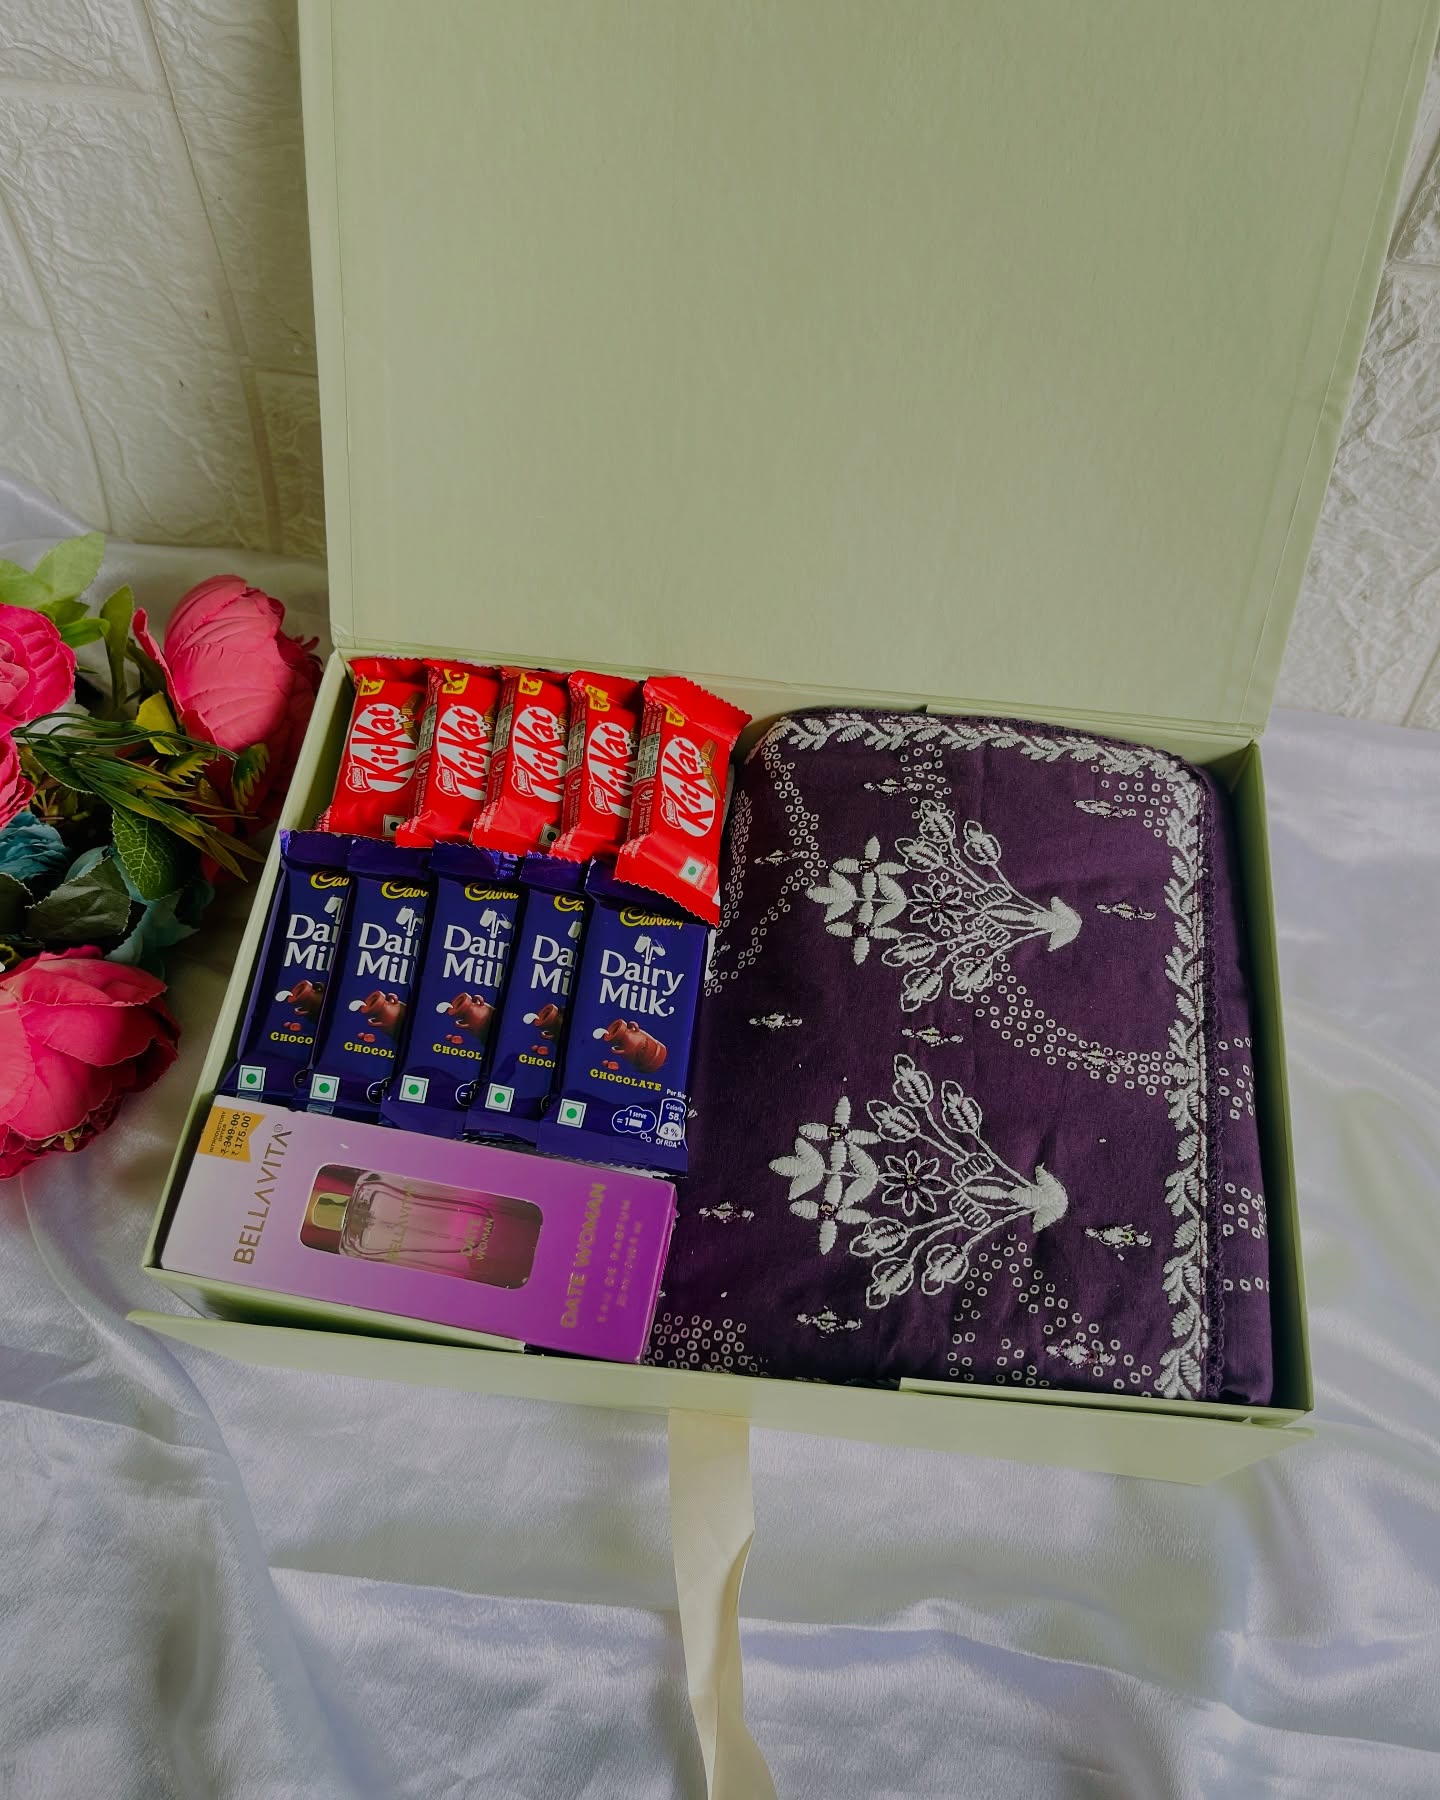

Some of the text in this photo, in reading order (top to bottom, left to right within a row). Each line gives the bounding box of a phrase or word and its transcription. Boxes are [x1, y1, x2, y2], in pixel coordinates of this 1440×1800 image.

[599, 949, 685, 996] Dairy
[599, 978, 675, 1018] Milk
[589, 1068, 662, 1091] CHOCOLATE
[668, 1112, 680, 1121] 58
[476, 1217, 495, 1260] WOMAN
[560, 1183, 607, 1328] DATE WOMAN
